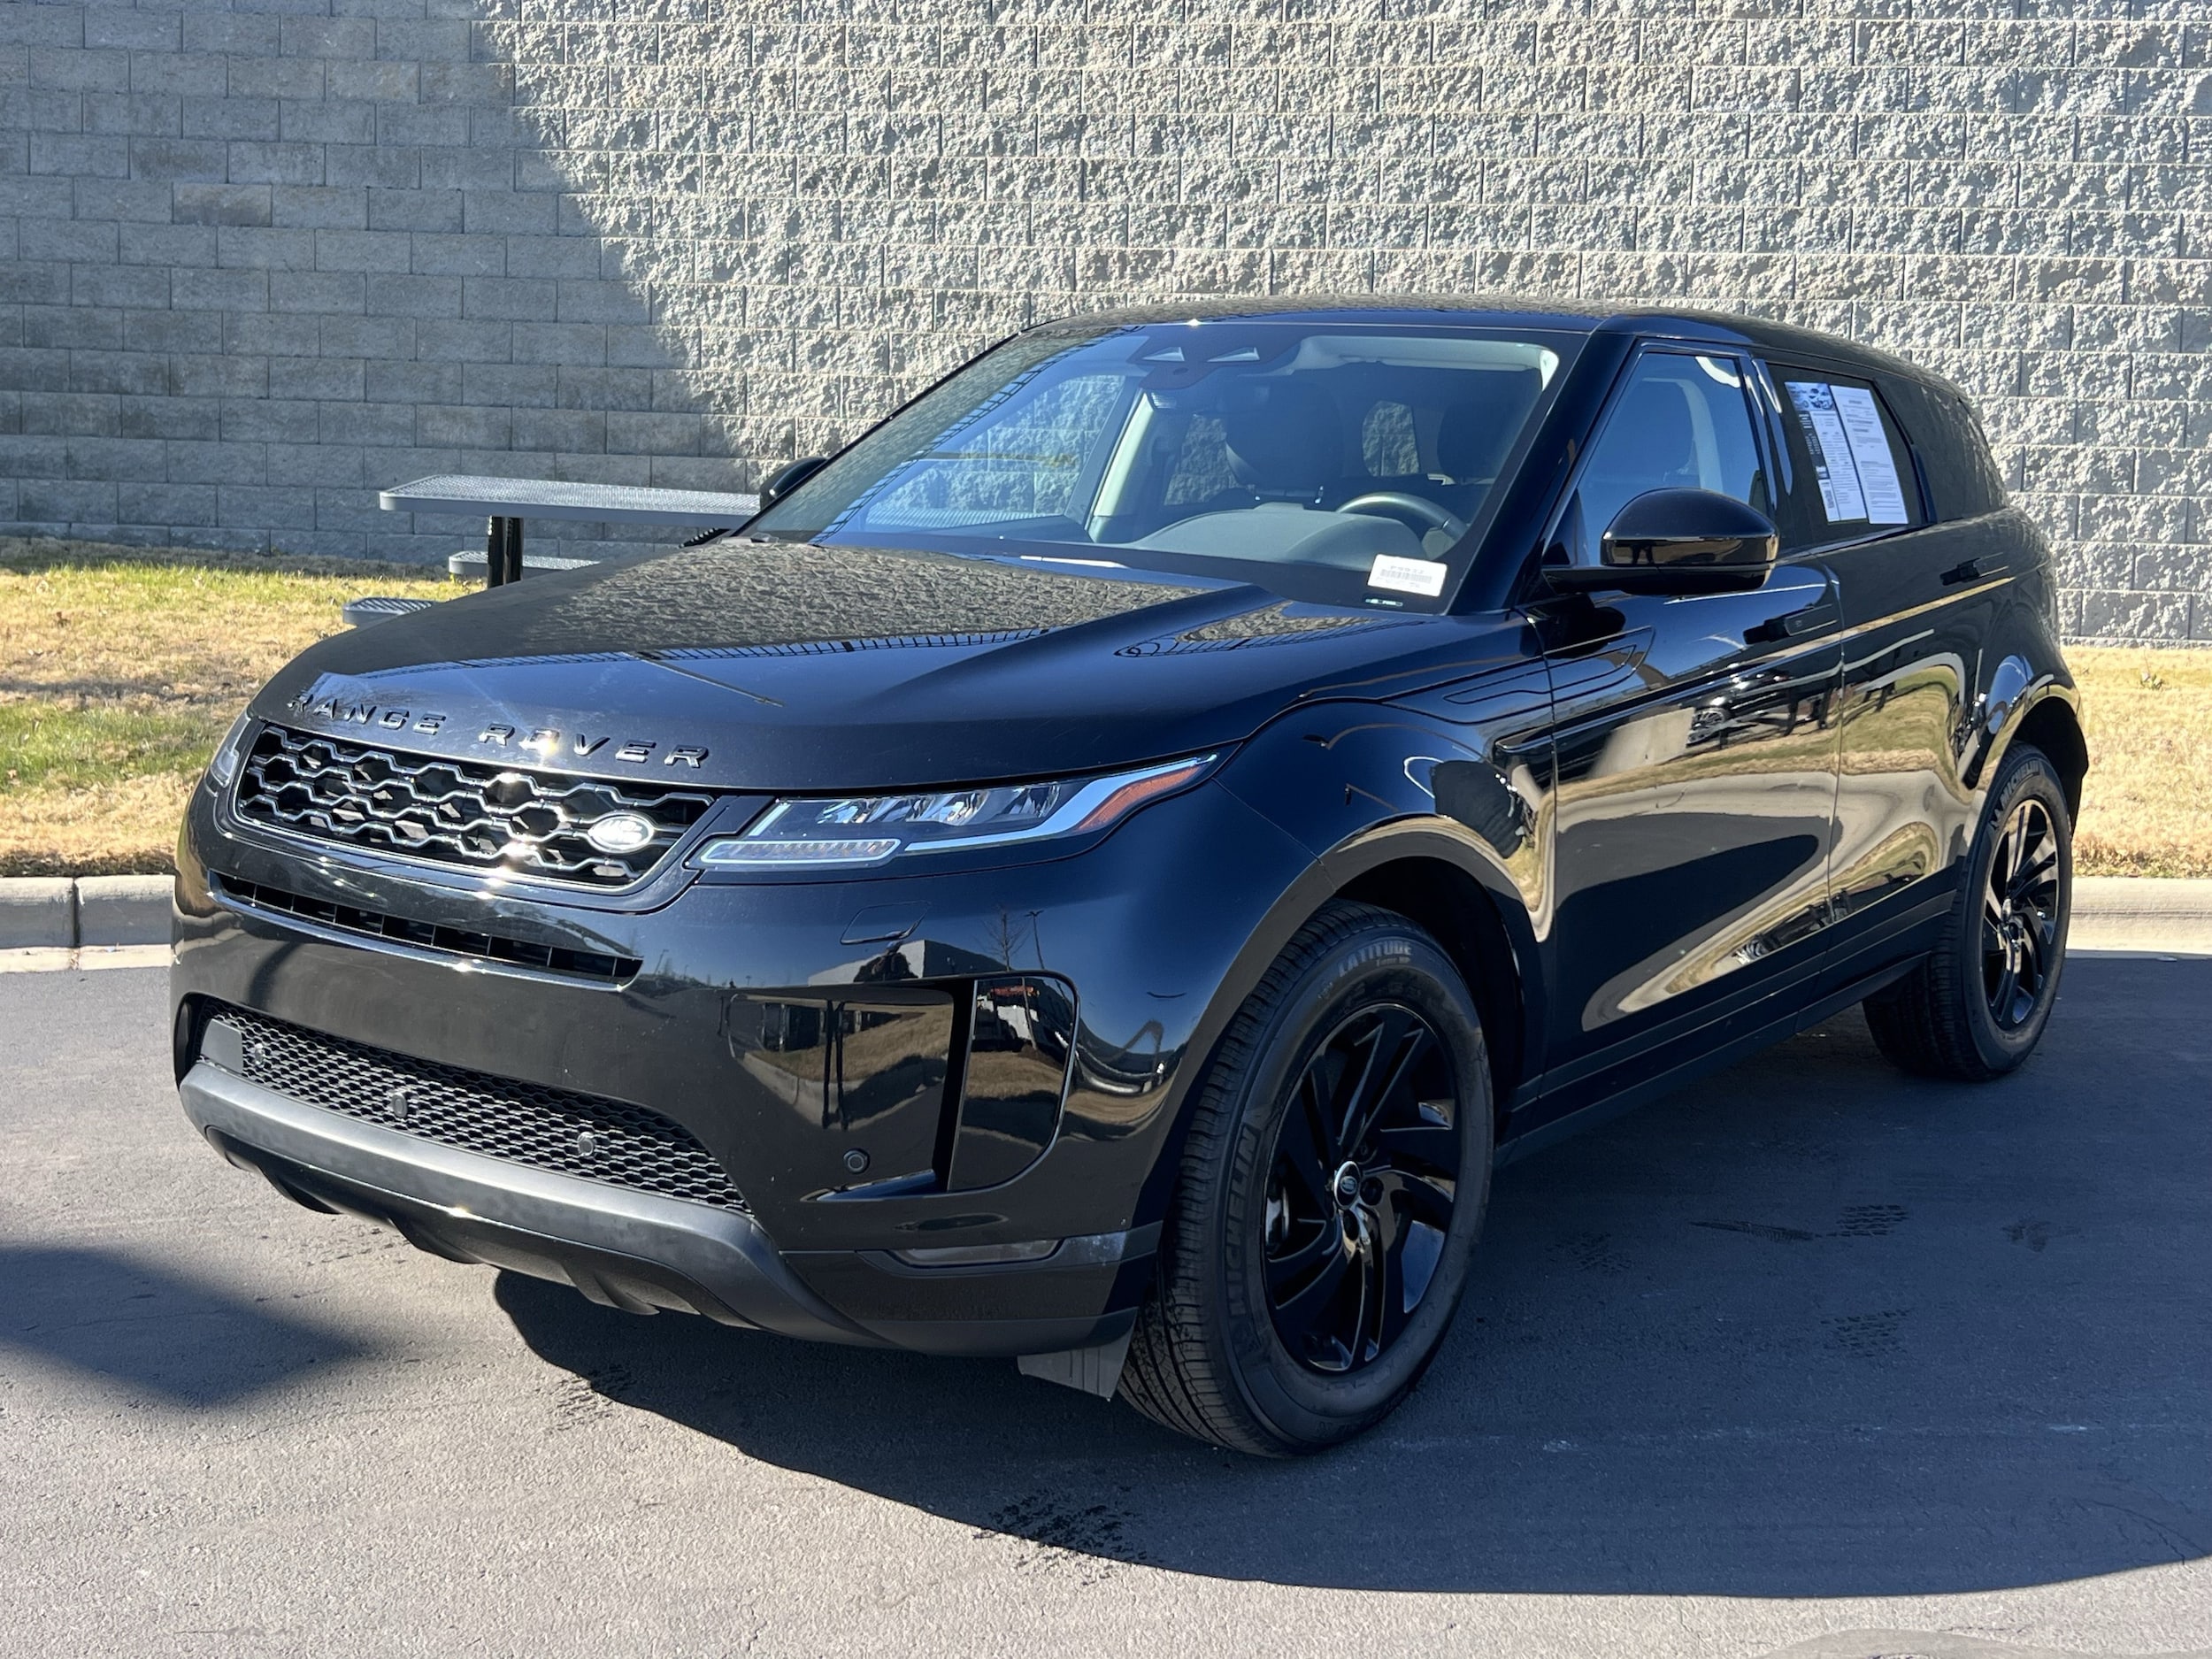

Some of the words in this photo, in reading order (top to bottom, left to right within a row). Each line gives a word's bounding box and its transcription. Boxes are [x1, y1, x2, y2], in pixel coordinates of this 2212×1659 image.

[288, 694, 446, 735] RANGE
[479, 723, 709, 768] ROVER
[1337, 941, 1414, 978] LATITUDE
[1225, 1125, 1257, 1317] MICHELIN
